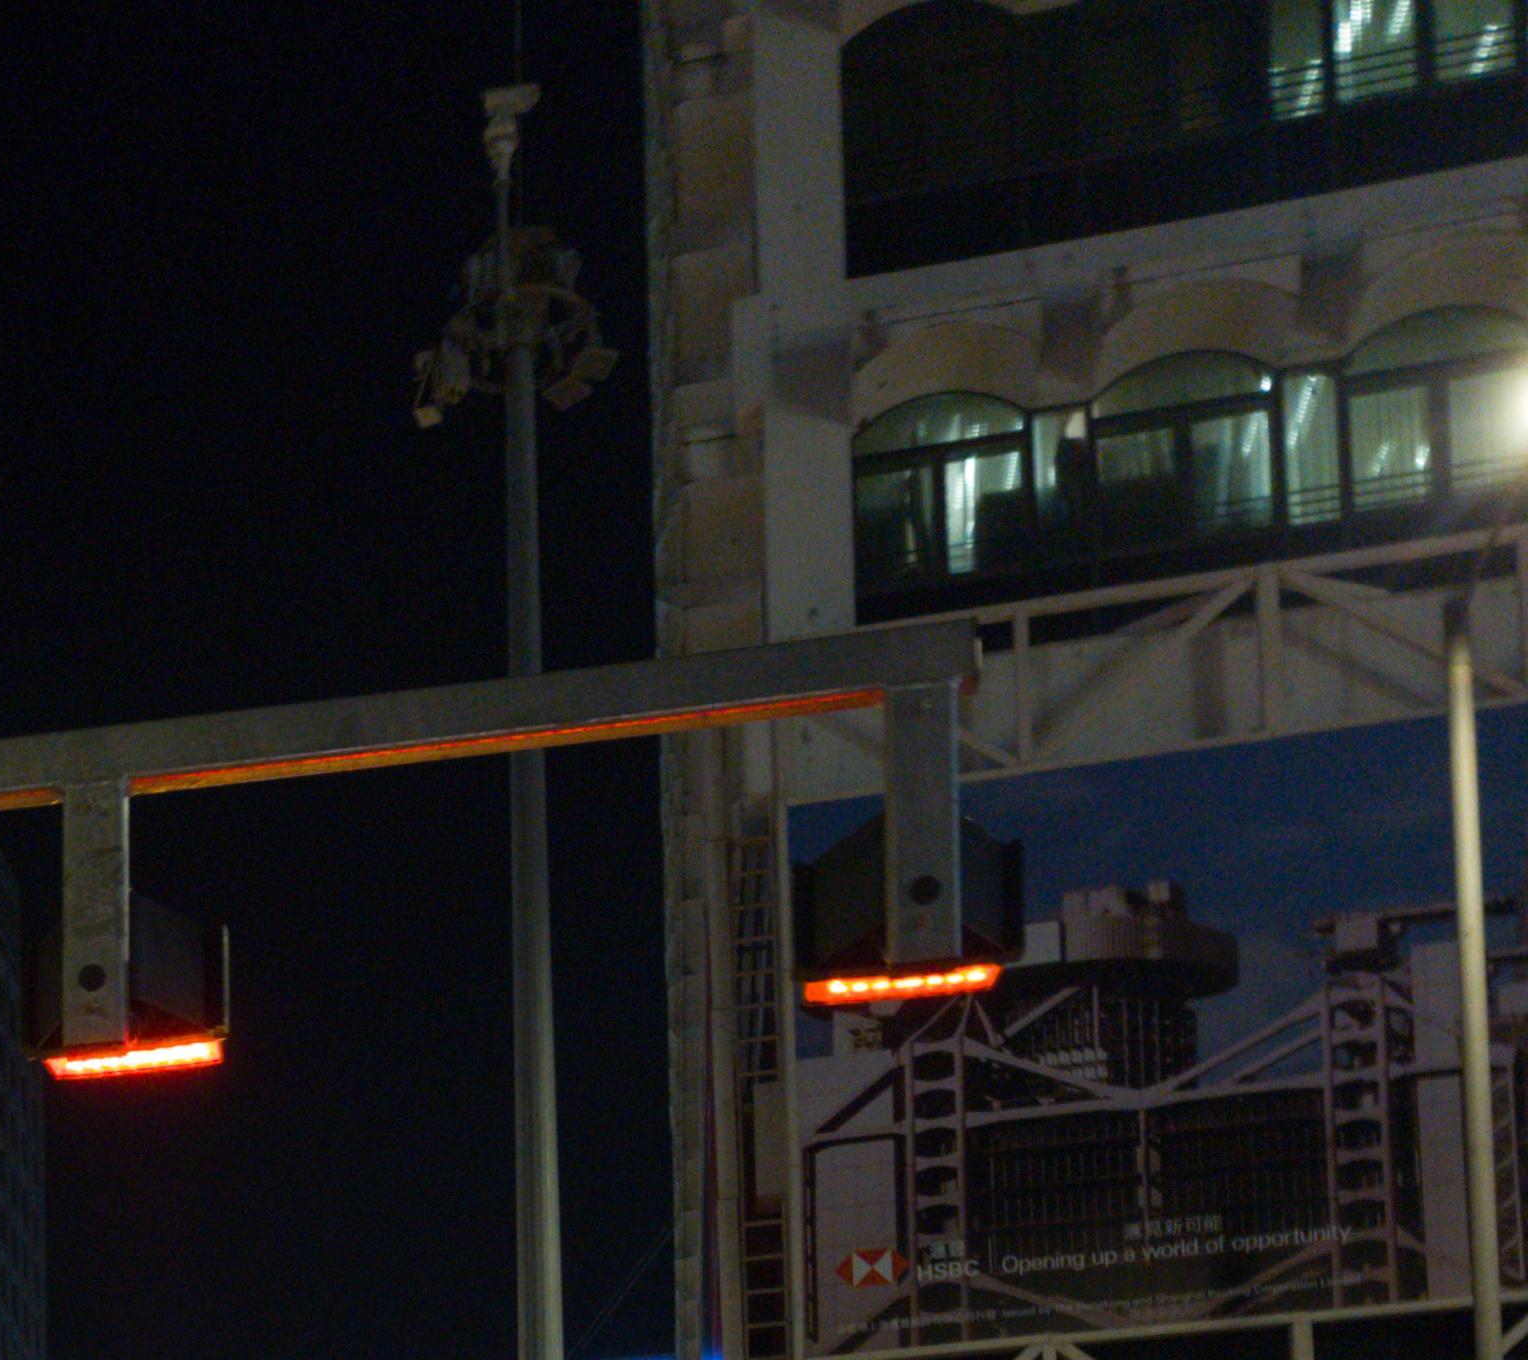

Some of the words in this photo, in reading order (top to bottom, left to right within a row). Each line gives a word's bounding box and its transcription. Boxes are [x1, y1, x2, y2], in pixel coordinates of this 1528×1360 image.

[1001, 1250, 1086, 1276] Opening
[1091, 1249, 1119, 1270] up
[1124, 1248, 1136, 1263] a
[1141, 1237, 1200, 1261] world
[1205, 1236, 1225, 1255] of
[1231, 1224, 1354, 1253] opportunity
[916, 1258, 981, 1283] HSBC
